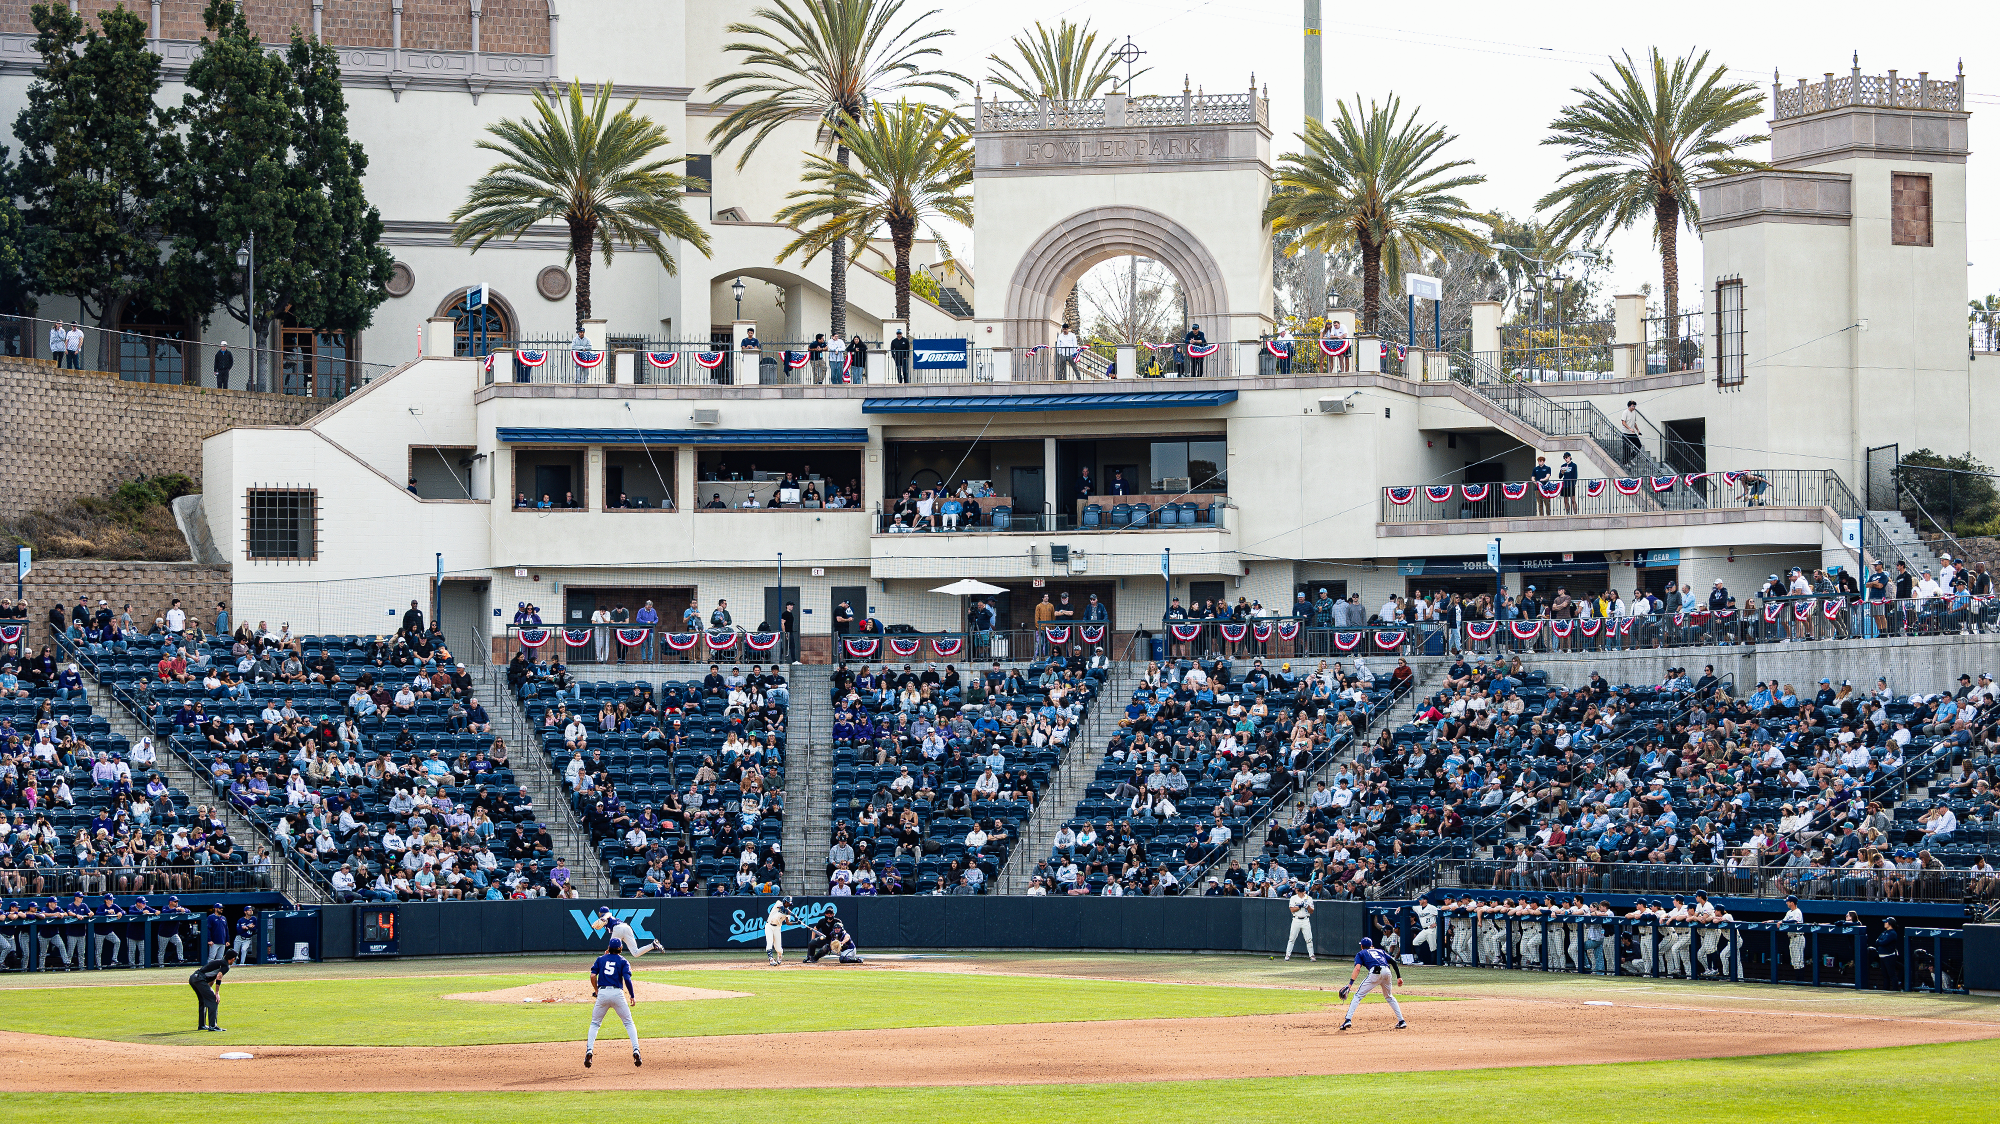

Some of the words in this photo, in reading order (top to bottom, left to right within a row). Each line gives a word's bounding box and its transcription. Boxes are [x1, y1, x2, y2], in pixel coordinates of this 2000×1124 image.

[1026, 139, 1131, 160] FOWLER
[1134, 137, 1201, 157] PARK
[913, 349, 967, 363] TOREROS
[1849, 533, 1854, 541] 8
[1521, 559, 1553, 569] TREATS
[1653, 553, 1670, 562] GEAR
[378, 912, 394, 940] 4
[729, 909, 767, 935] San
[603, 960, 617, 976] 5
